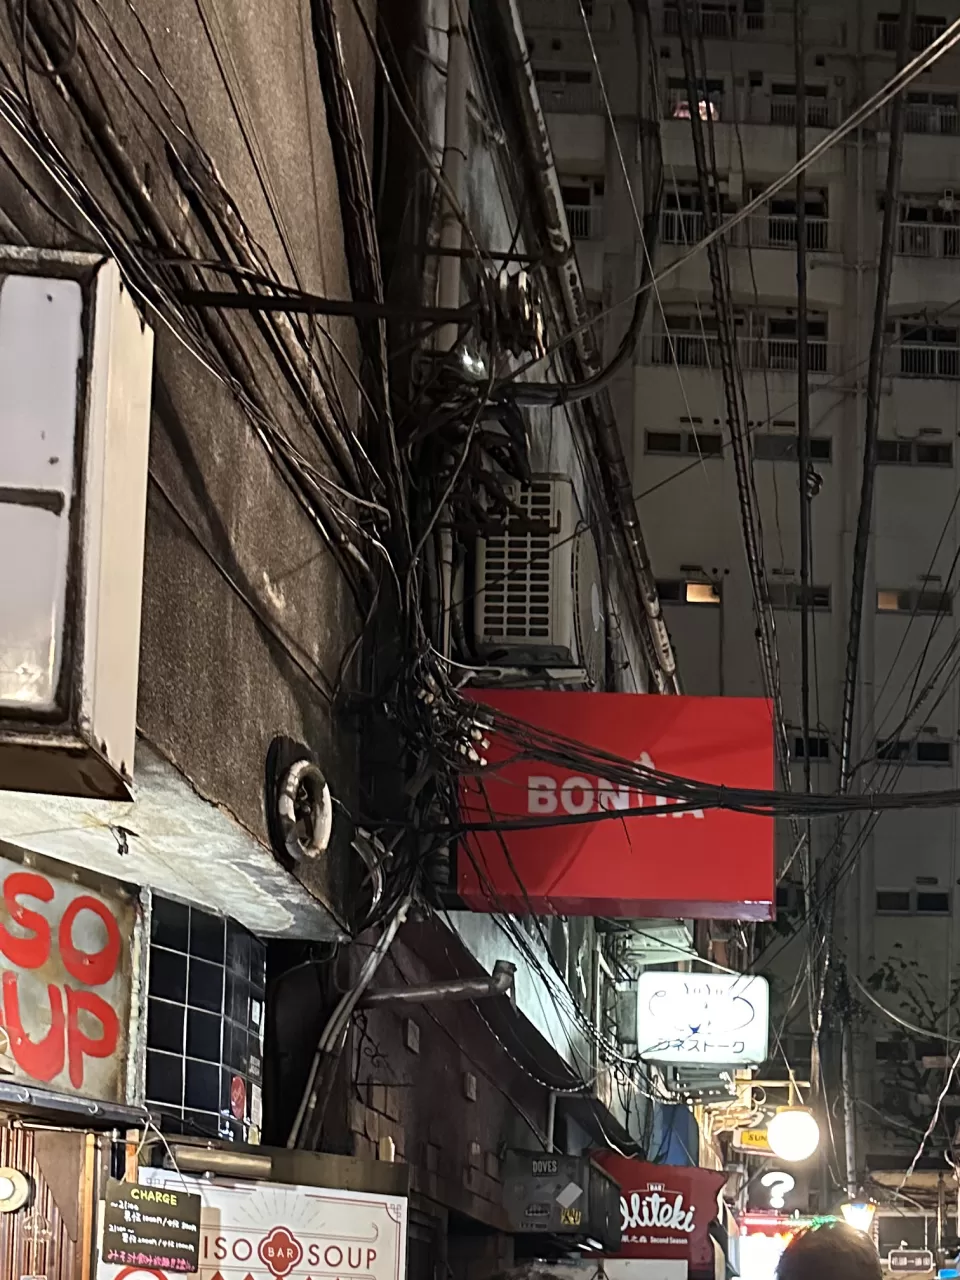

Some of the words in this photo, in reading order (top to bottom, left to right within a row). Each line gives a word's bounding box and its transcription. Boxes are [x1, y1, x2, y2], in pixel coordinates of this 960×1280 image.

[532, 1160, 557, 1173] DOVES
[130, 1188, 177, 1206] CHARGE
[203, 1235, 253, 1262] ISO
[267, 1246, 294, 1259] BAR
[307, 1243, 377, 1269] SOUP
